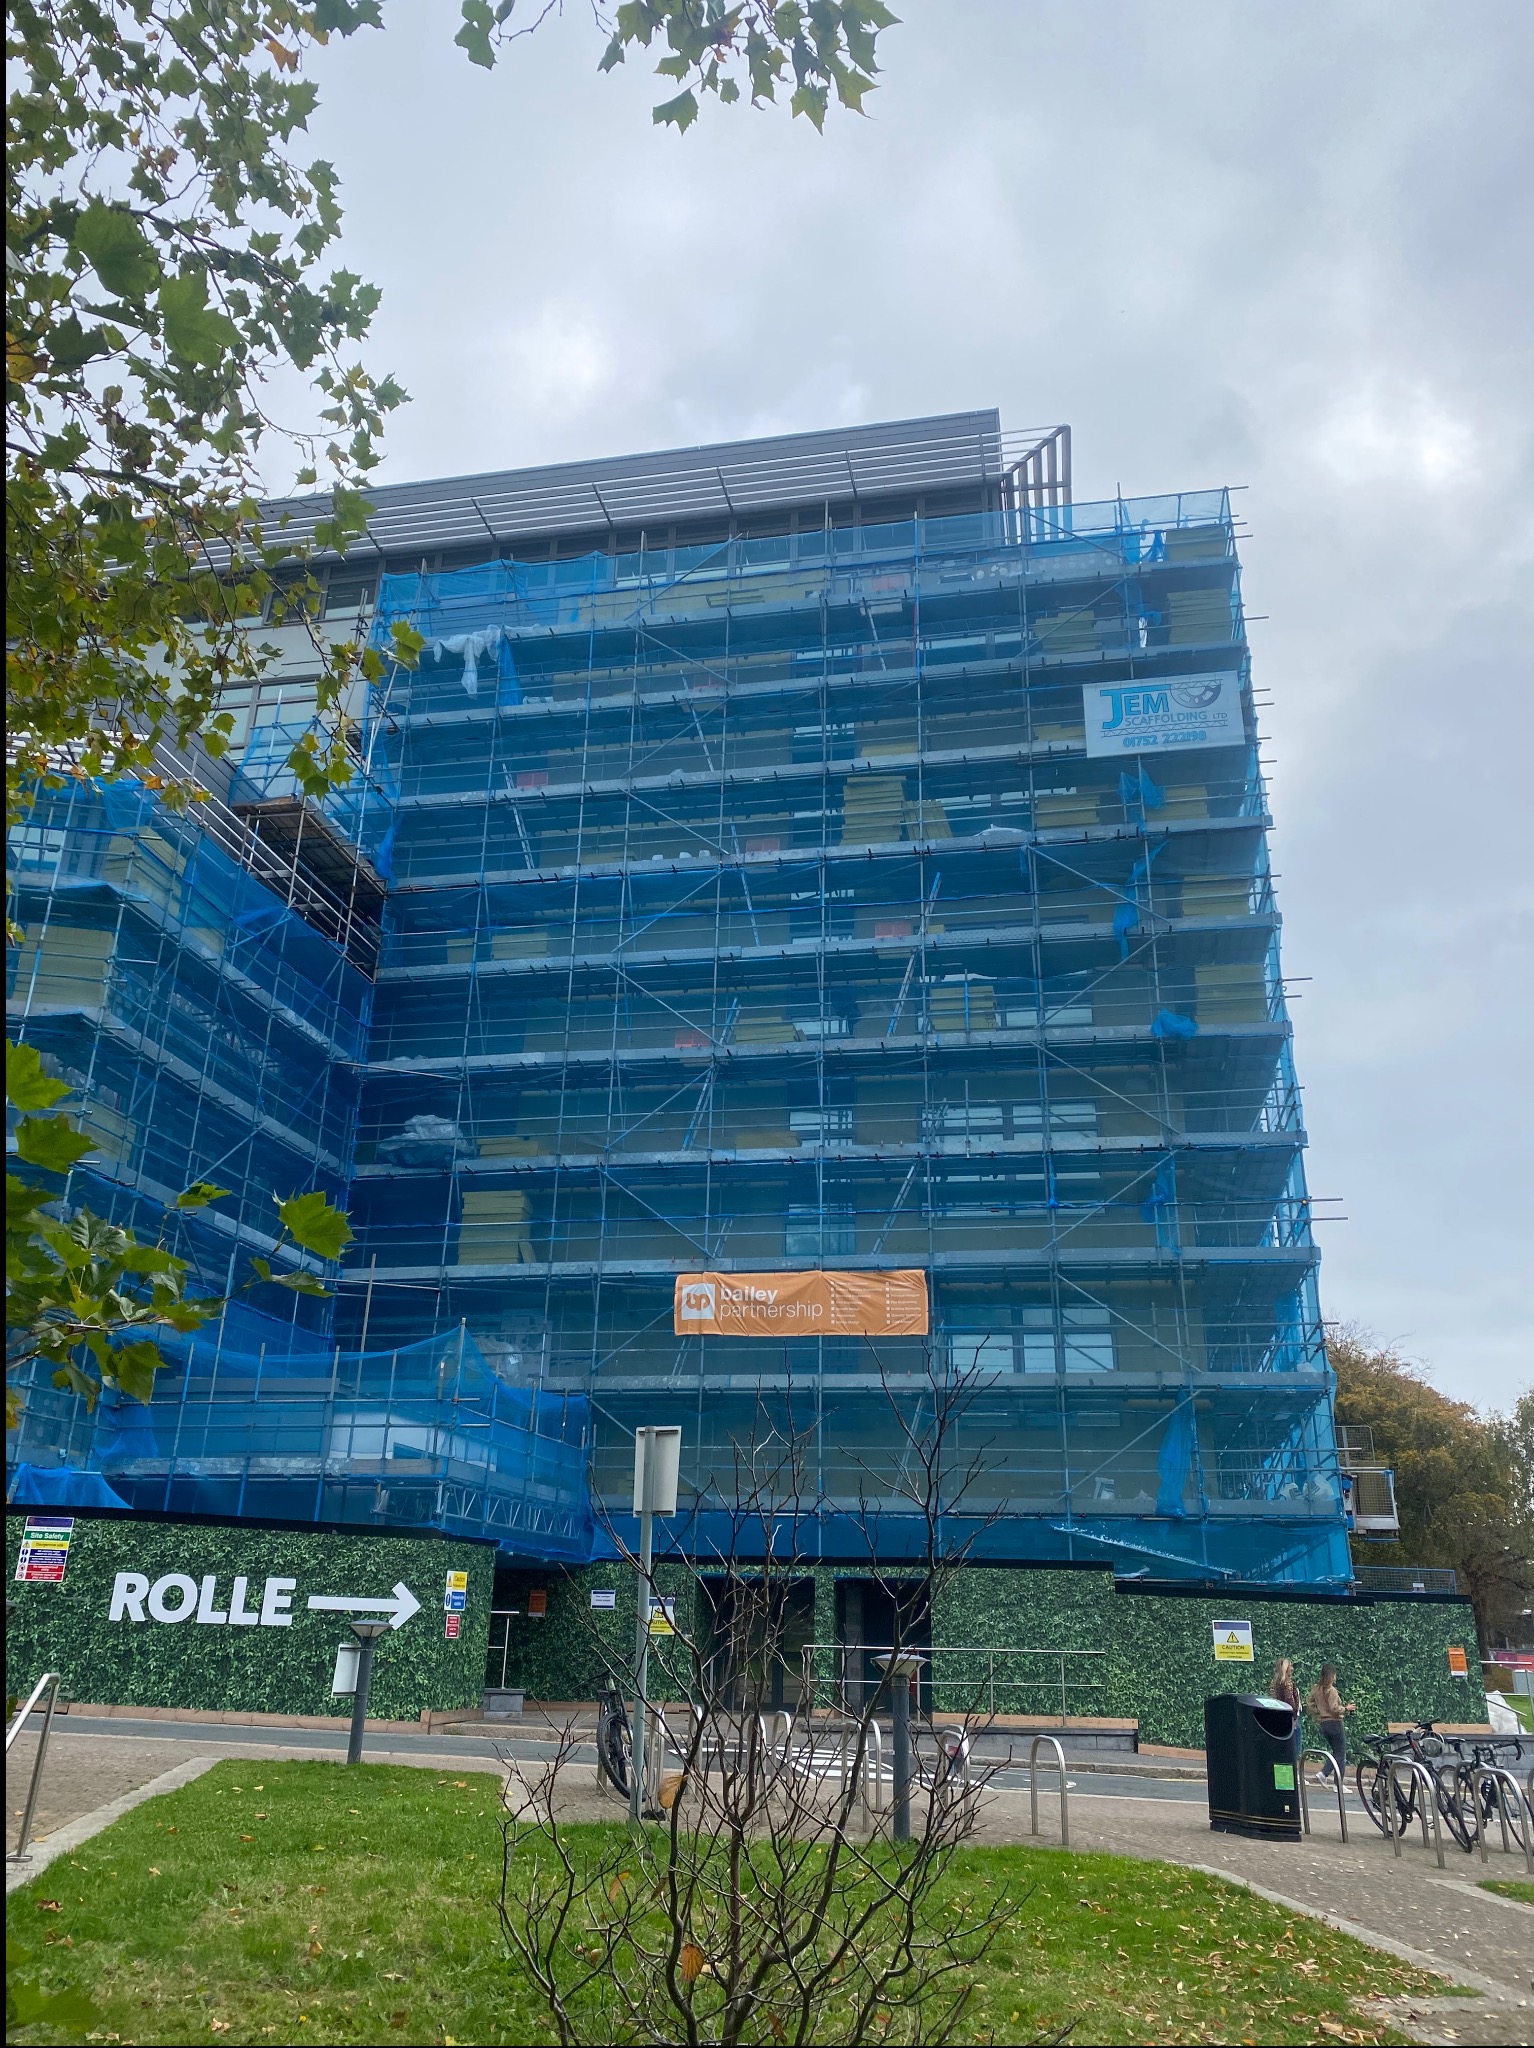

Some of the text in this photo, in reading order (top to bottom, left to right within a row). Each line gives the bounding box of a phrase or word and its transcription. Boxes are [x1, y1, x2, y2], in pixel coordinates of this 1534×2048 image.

[1100, 684, 1171, 730] JEM
[1125, 711, 1228, 727] SCAFFOLDING LTD
[1123, 730, 1207, 748] 01752 222198
[720, 1284, 779, 1305] bailey
[720, 1300, 823, 1321] partnership
[44, 1532, 64, 1540] Safety
[109, 1572, 297, 1626] ROLLE
